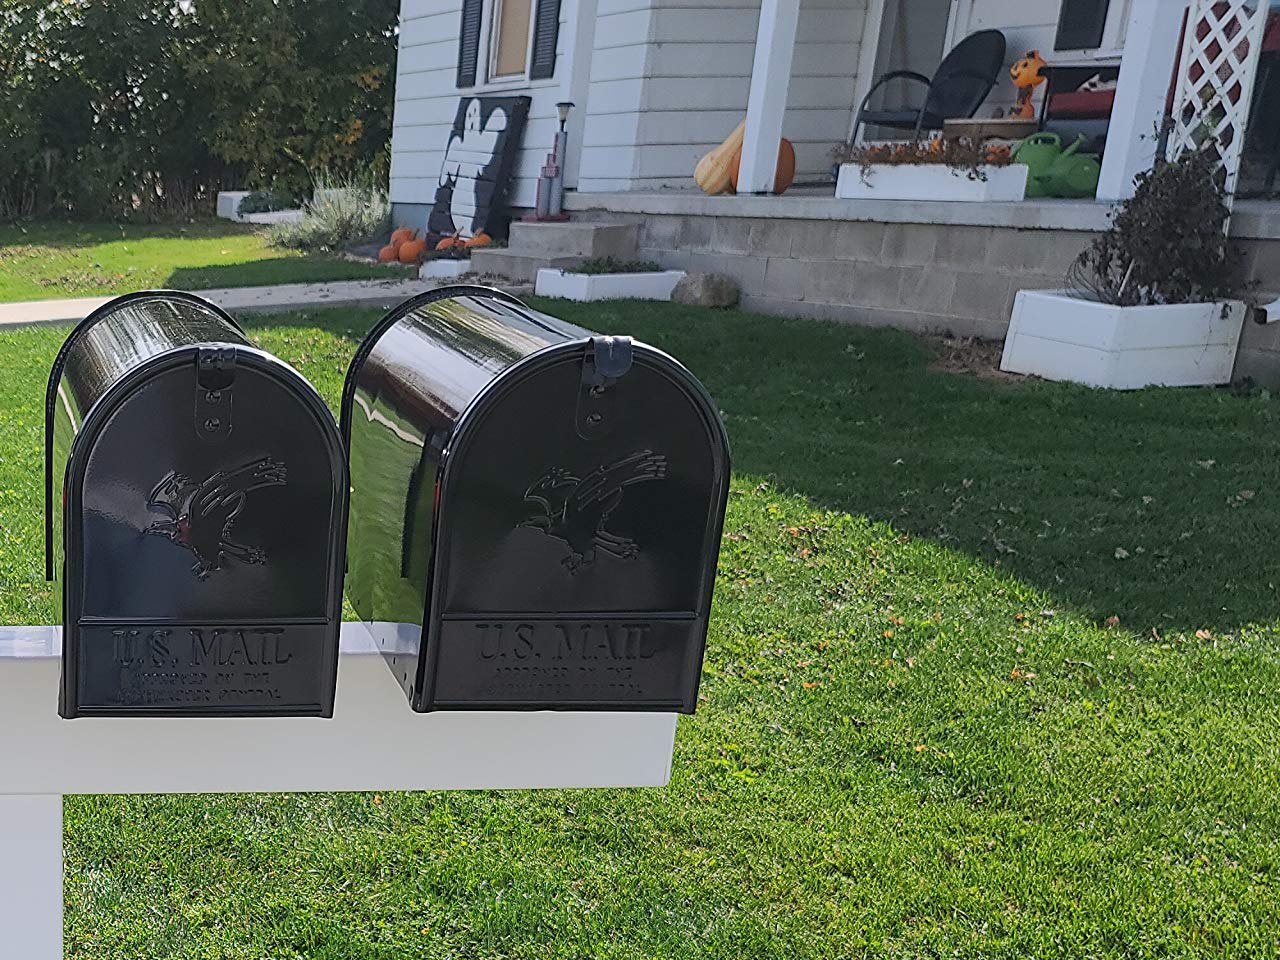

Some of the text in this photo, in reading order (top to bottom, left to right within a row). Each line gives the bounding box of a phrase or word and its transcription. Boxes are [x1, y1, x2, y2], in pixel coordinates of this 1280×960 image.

[111, 628, 293, 668] U.S. MAIL
[475, 623, 656, 660] U.S. MAIL
